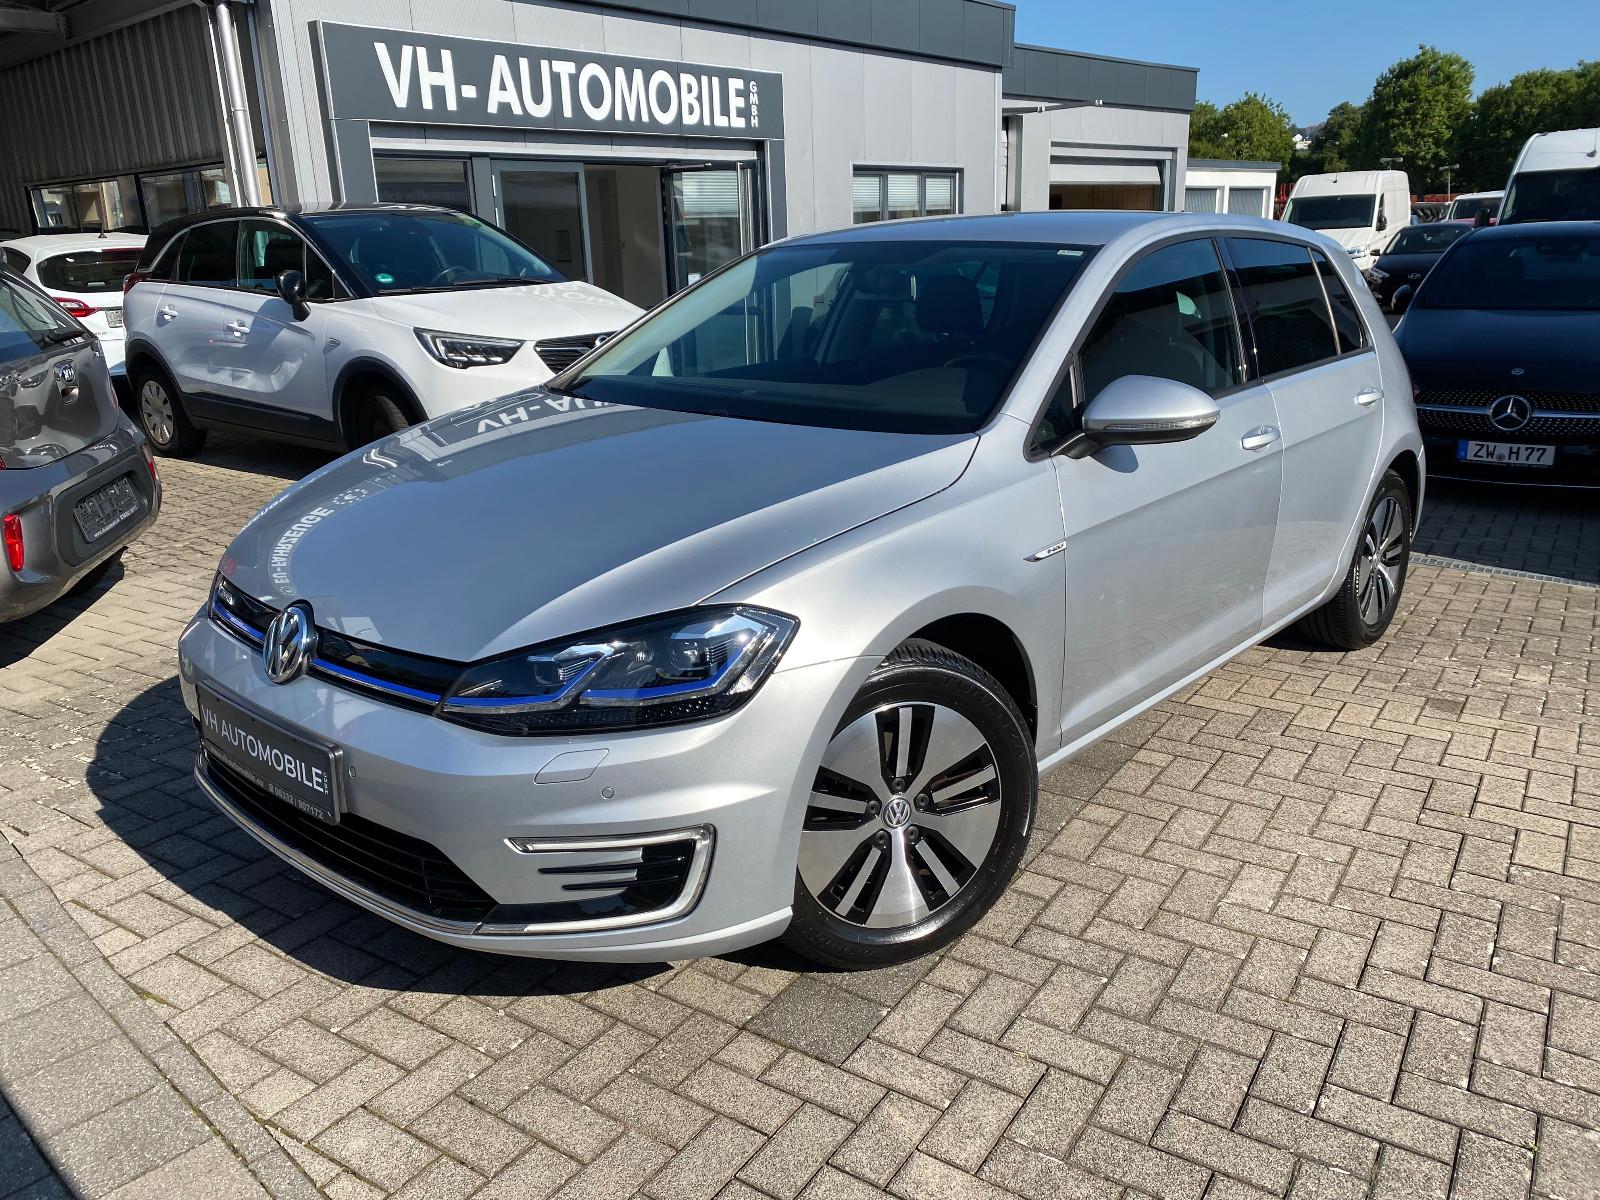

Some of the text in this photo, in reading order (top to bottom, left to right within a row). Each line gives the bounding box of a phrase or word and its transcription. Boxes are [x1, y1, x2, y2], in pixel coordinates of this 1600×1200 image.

[487, 54, 747, 128] AUTOMOBILE
[749, 80, 759, 128] GMBH
[1473, 443, 1497, 460] ZW
[201, 704, 324, 793] VH AUTOMOBILE
